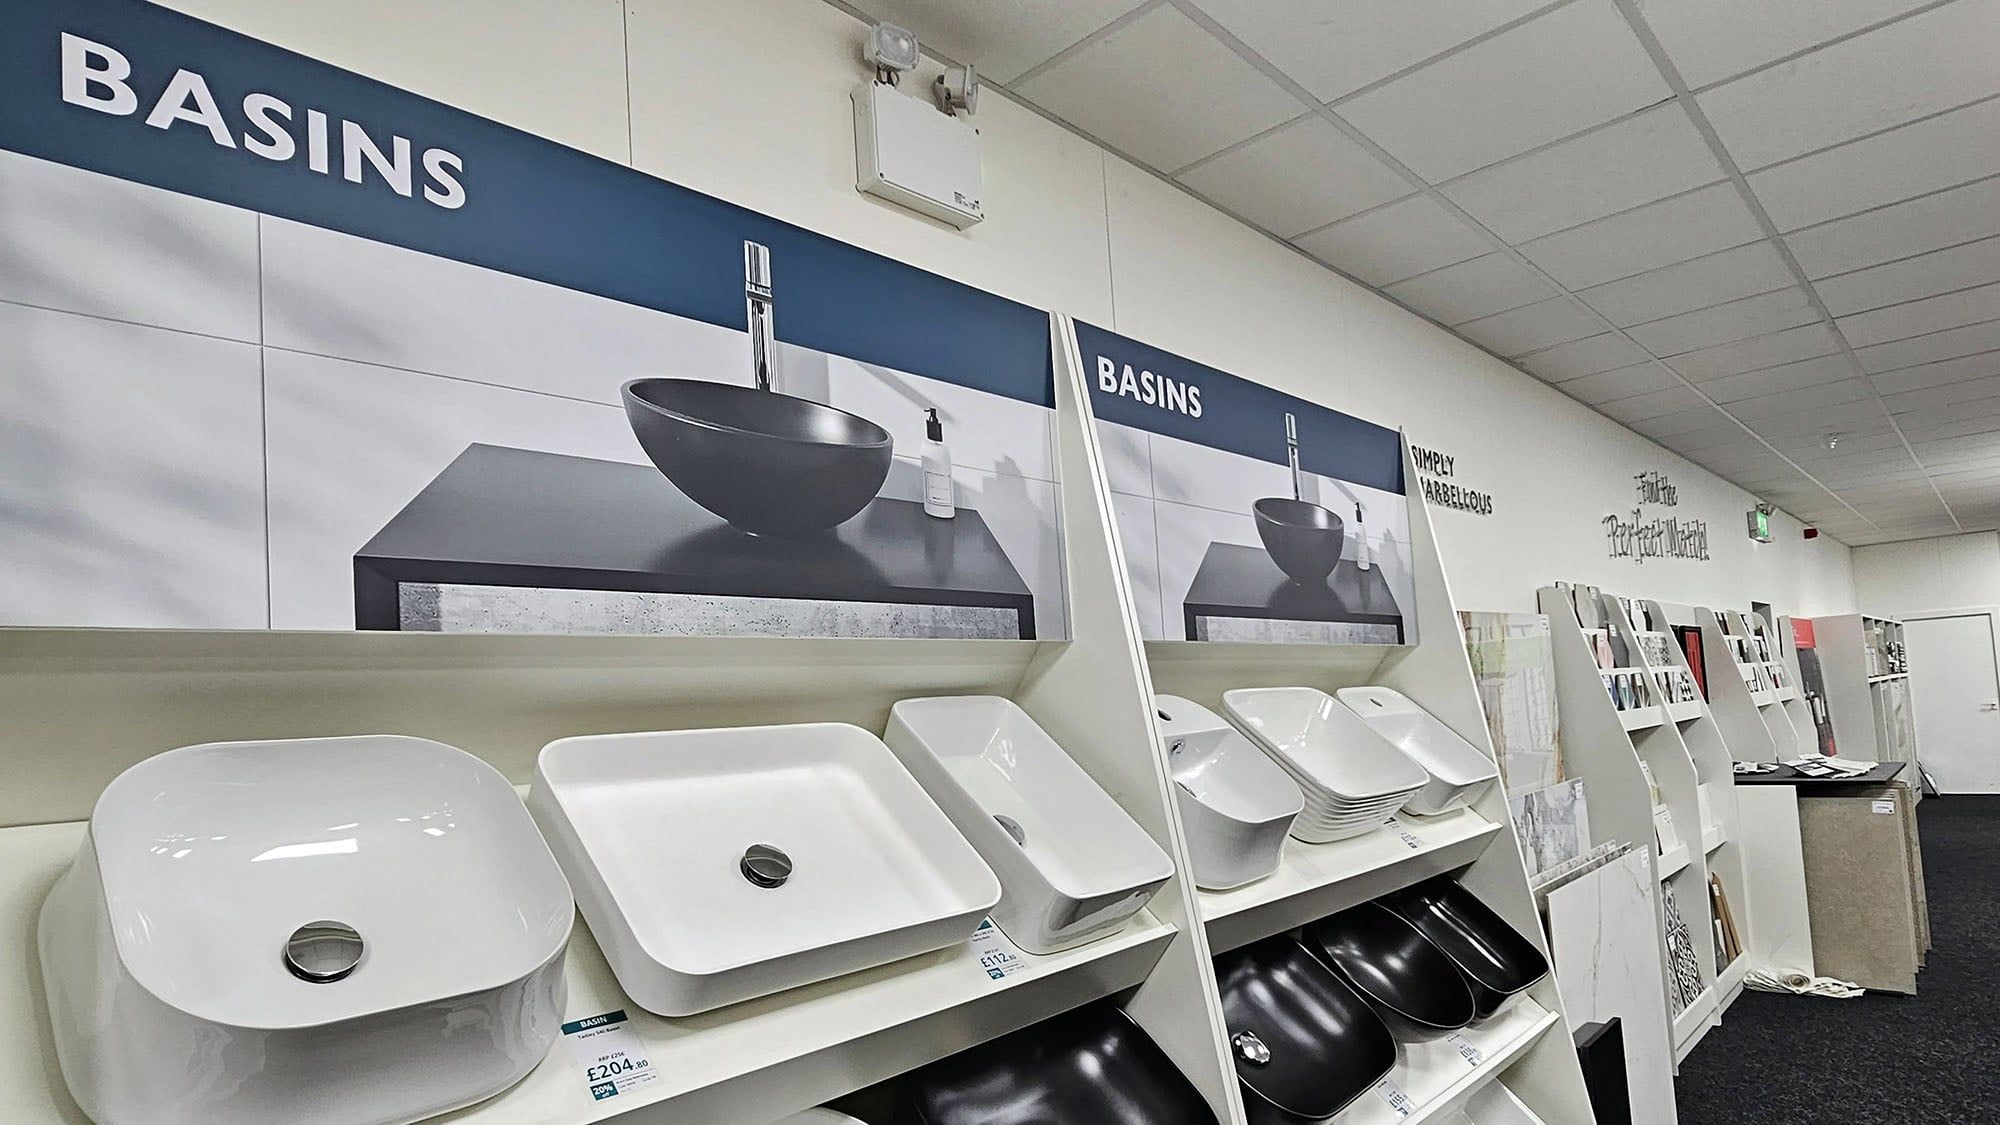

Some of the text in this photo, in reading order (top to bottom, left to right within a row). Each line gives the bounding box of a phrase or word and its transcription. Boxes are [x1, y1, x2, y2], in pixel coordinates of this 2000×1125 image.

[61, 31, 467, 210] BASINS
[1097, 355, 1202, 418] BASINS
[1411, 445, 1455, 477] SIMPLY
[1602, 508, 1663, 564] Perfect
[579, 1016, 608, 1028] BASIN
[587, 1058, 649, 1082] £204.80
[592, 1083, 614, 1096] 20%
